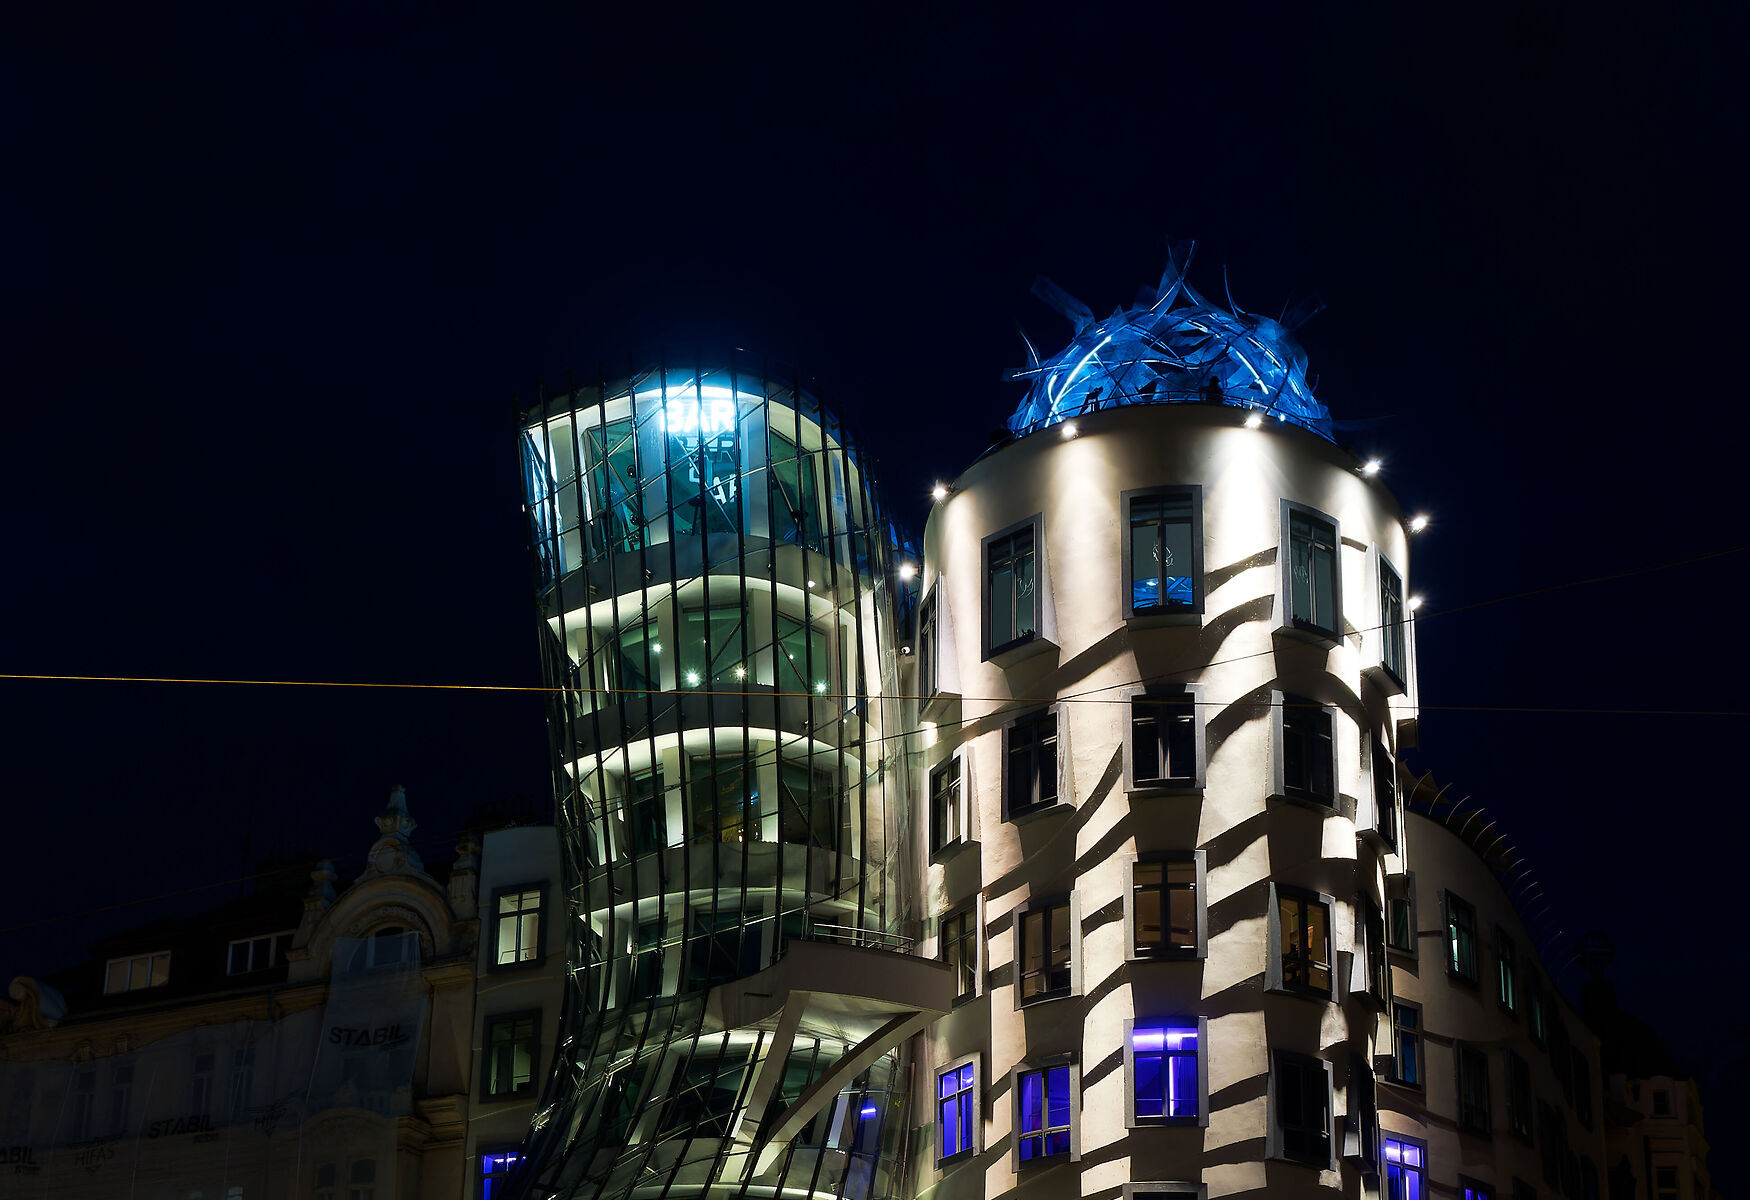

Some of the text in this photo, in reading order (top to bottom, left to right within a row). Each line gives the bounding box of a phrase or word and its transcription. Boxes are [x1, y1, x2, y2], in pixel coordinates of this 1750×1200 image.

[661, 398, 736, 434] BAR
[329, 1023, 409, 1046] STABIL
[147, 1114, 216, 1138] STABIL
